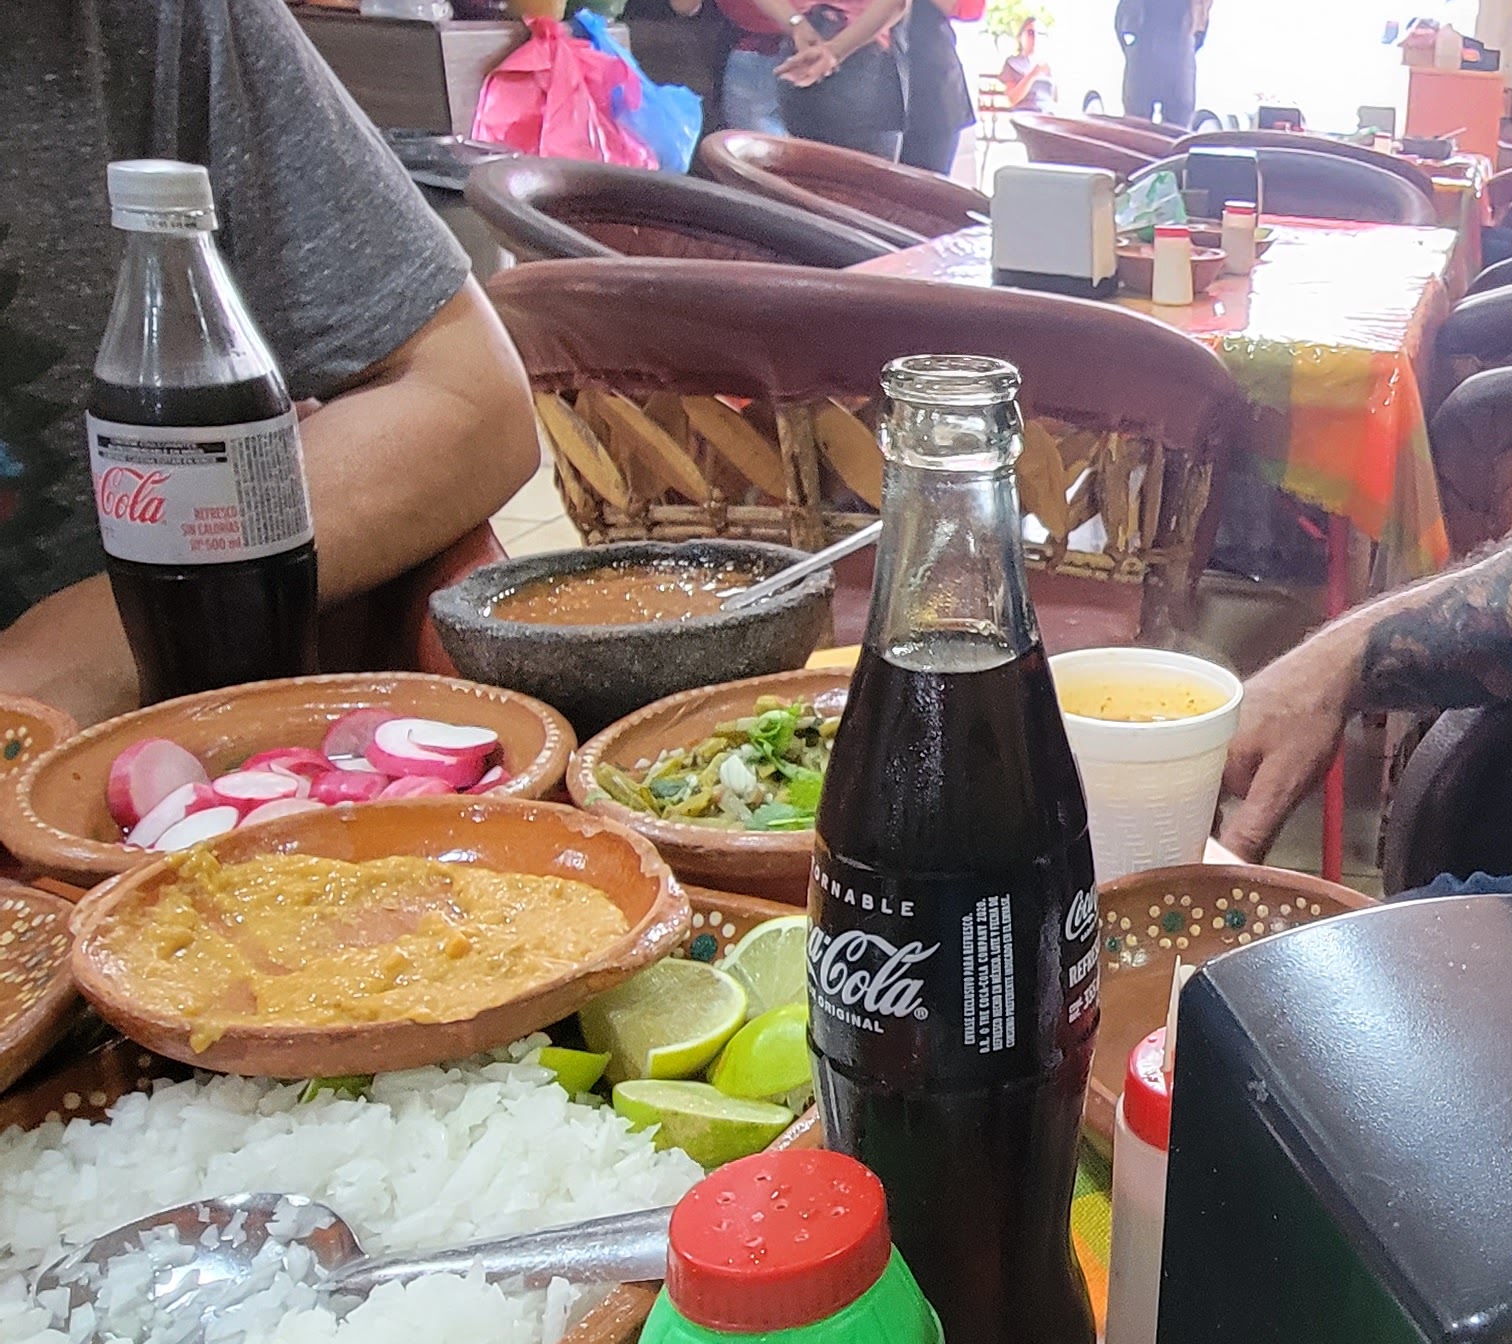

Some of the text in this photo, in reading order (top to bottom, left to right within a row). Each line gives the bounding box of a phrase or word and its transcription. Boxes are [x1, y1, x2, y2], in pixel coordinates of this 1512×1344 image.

[813, 865, 914, 917] ORNABLE
[977, 925, 987, 962] COMPANY
[978, 964, 988, 1007] COCA-COLA
[818, 995, 884, 1034] ORIGINAL
[979, 1009, 989, 1025] THE
